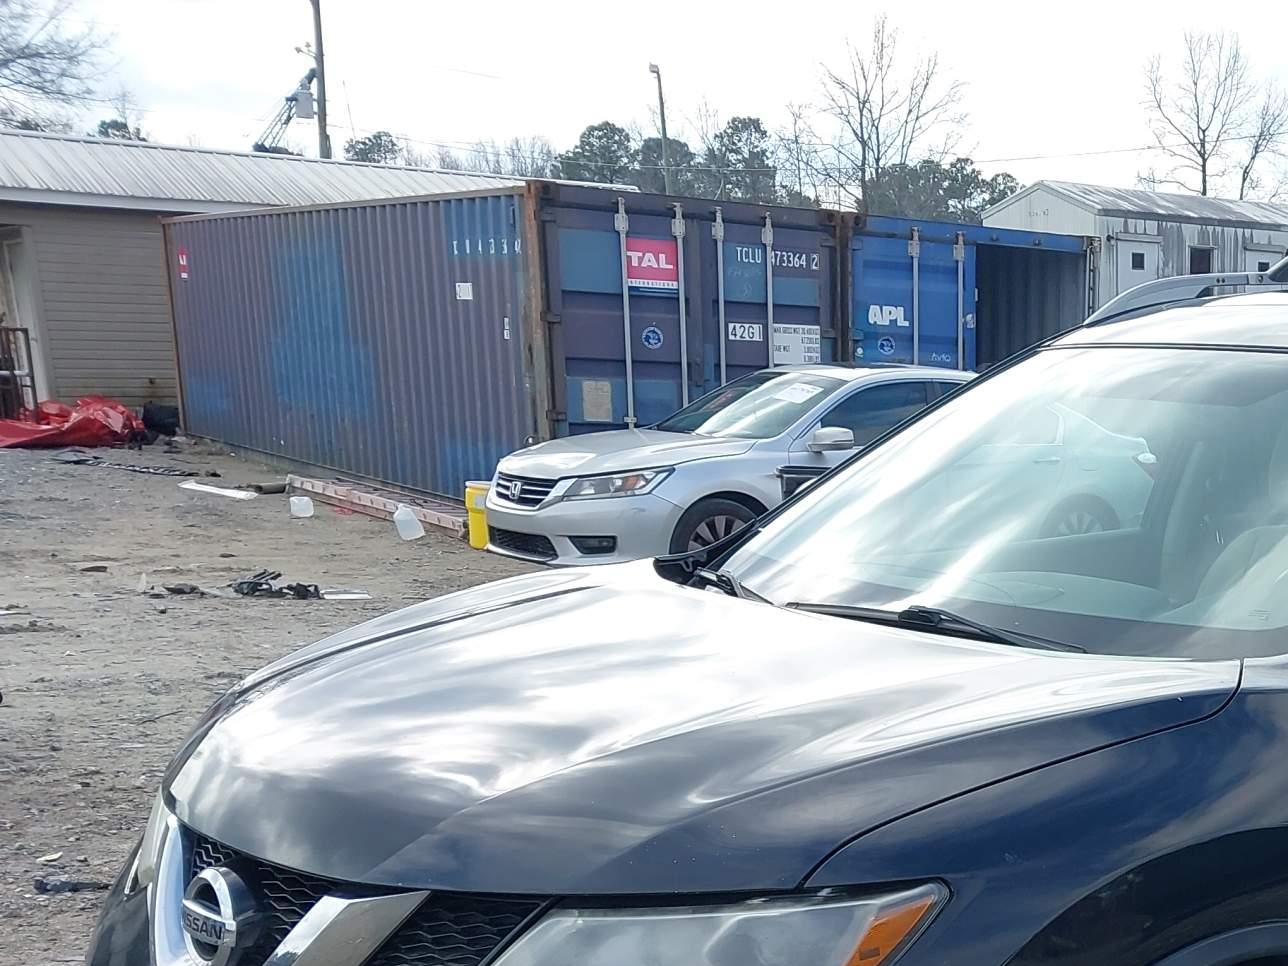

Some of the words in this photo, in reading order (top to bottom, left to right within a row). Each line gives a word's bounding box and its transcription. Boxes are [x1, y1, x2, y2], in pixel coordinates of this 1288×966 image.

[627, 251, 673, 269] TAL
[736, 246, 762, 264] TCLU
[868, 304, 910, 327] APL
